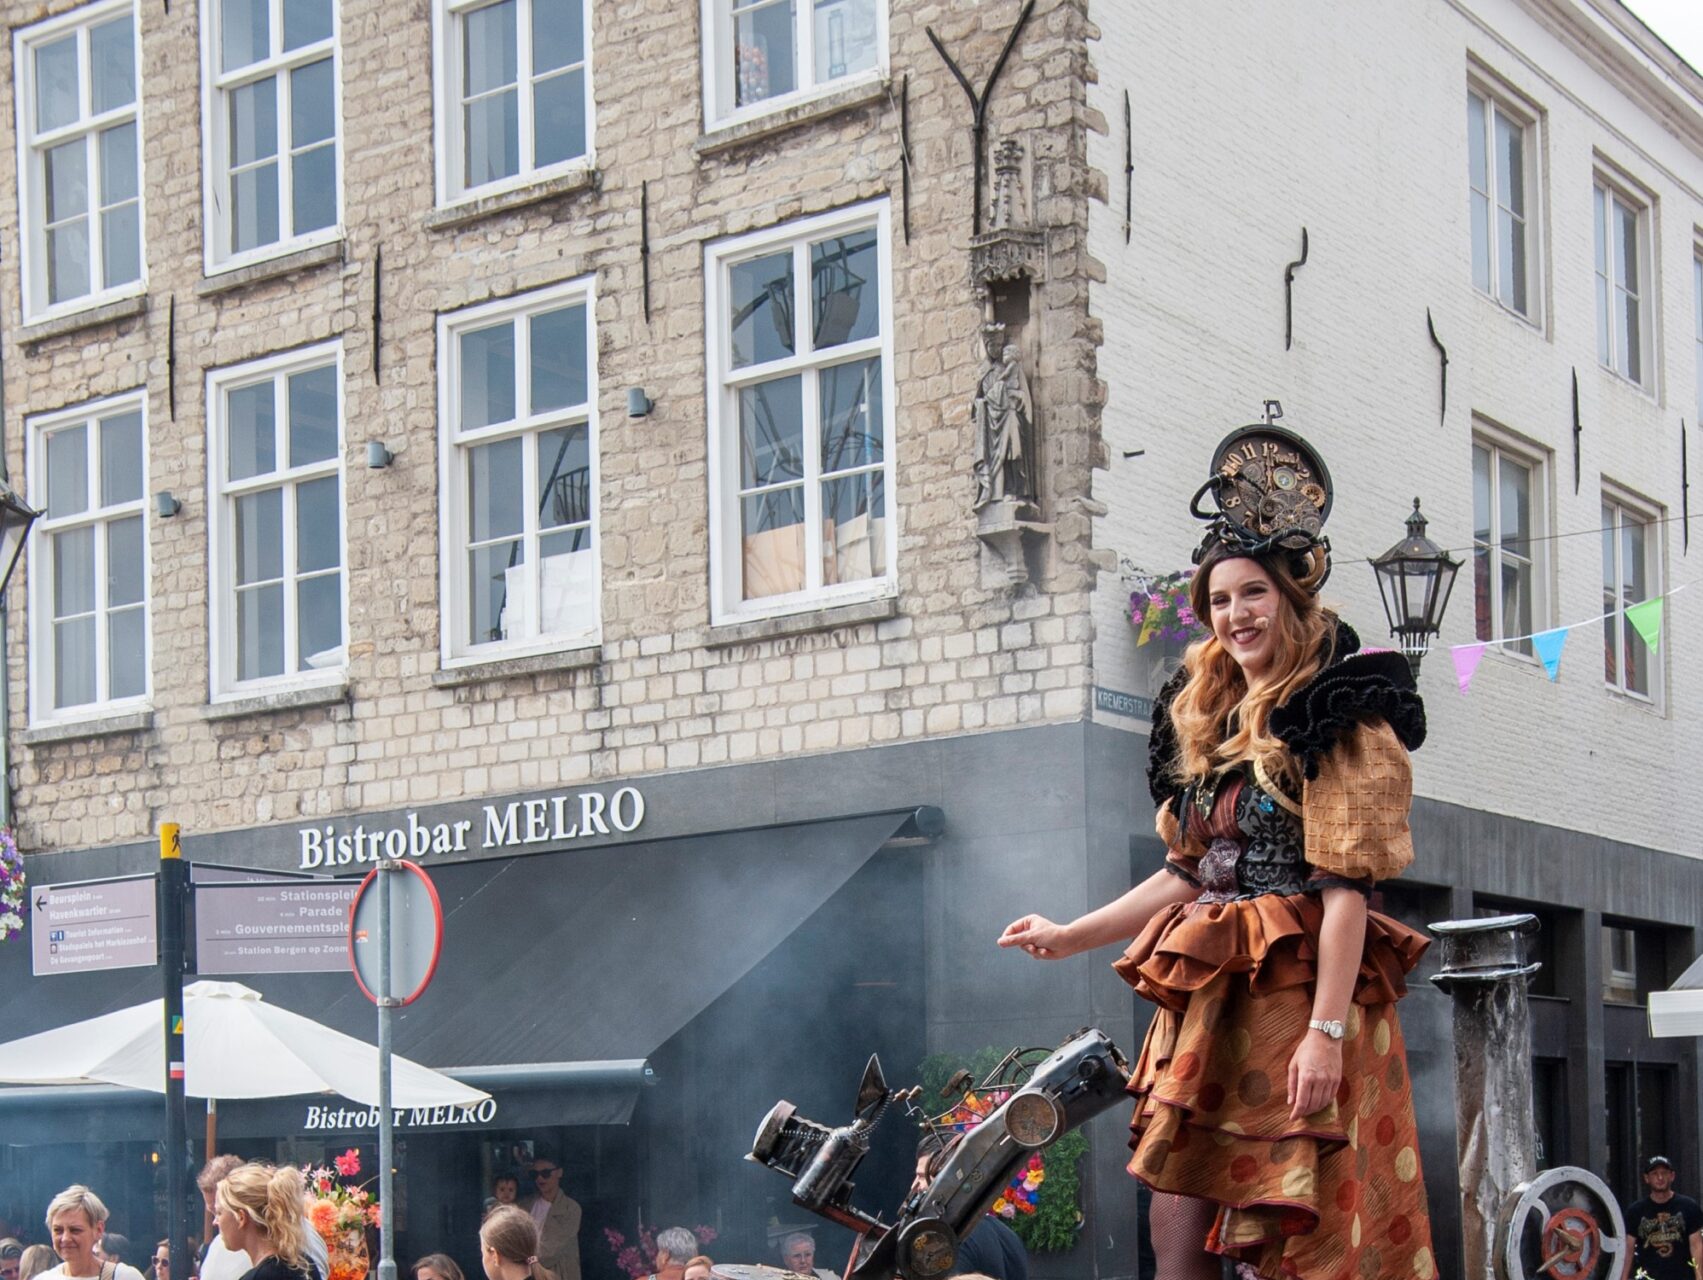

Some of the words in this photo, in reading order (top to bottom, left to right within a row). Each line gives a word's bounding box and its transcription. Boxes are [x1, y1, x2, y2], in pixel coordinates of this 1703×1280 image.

[299, 813, 472, 869] Bistrobar
[482, 786, 645, 849] MELRO
[49, 890, 92, 905] Beursplein
[49, 905, 107, 920] Havenkwartier
[299, 906, 343, 917] Parade
[235, 922, 349, 935] Gouvernementsple
[238, 945, 272, 955] Station
[273, 945, 306, 957] Bergen
[309, 946, 321, 955] op
[322, 944, 348, 954] Zoom
[304, 1105, 404, 1129] Bistrobr
